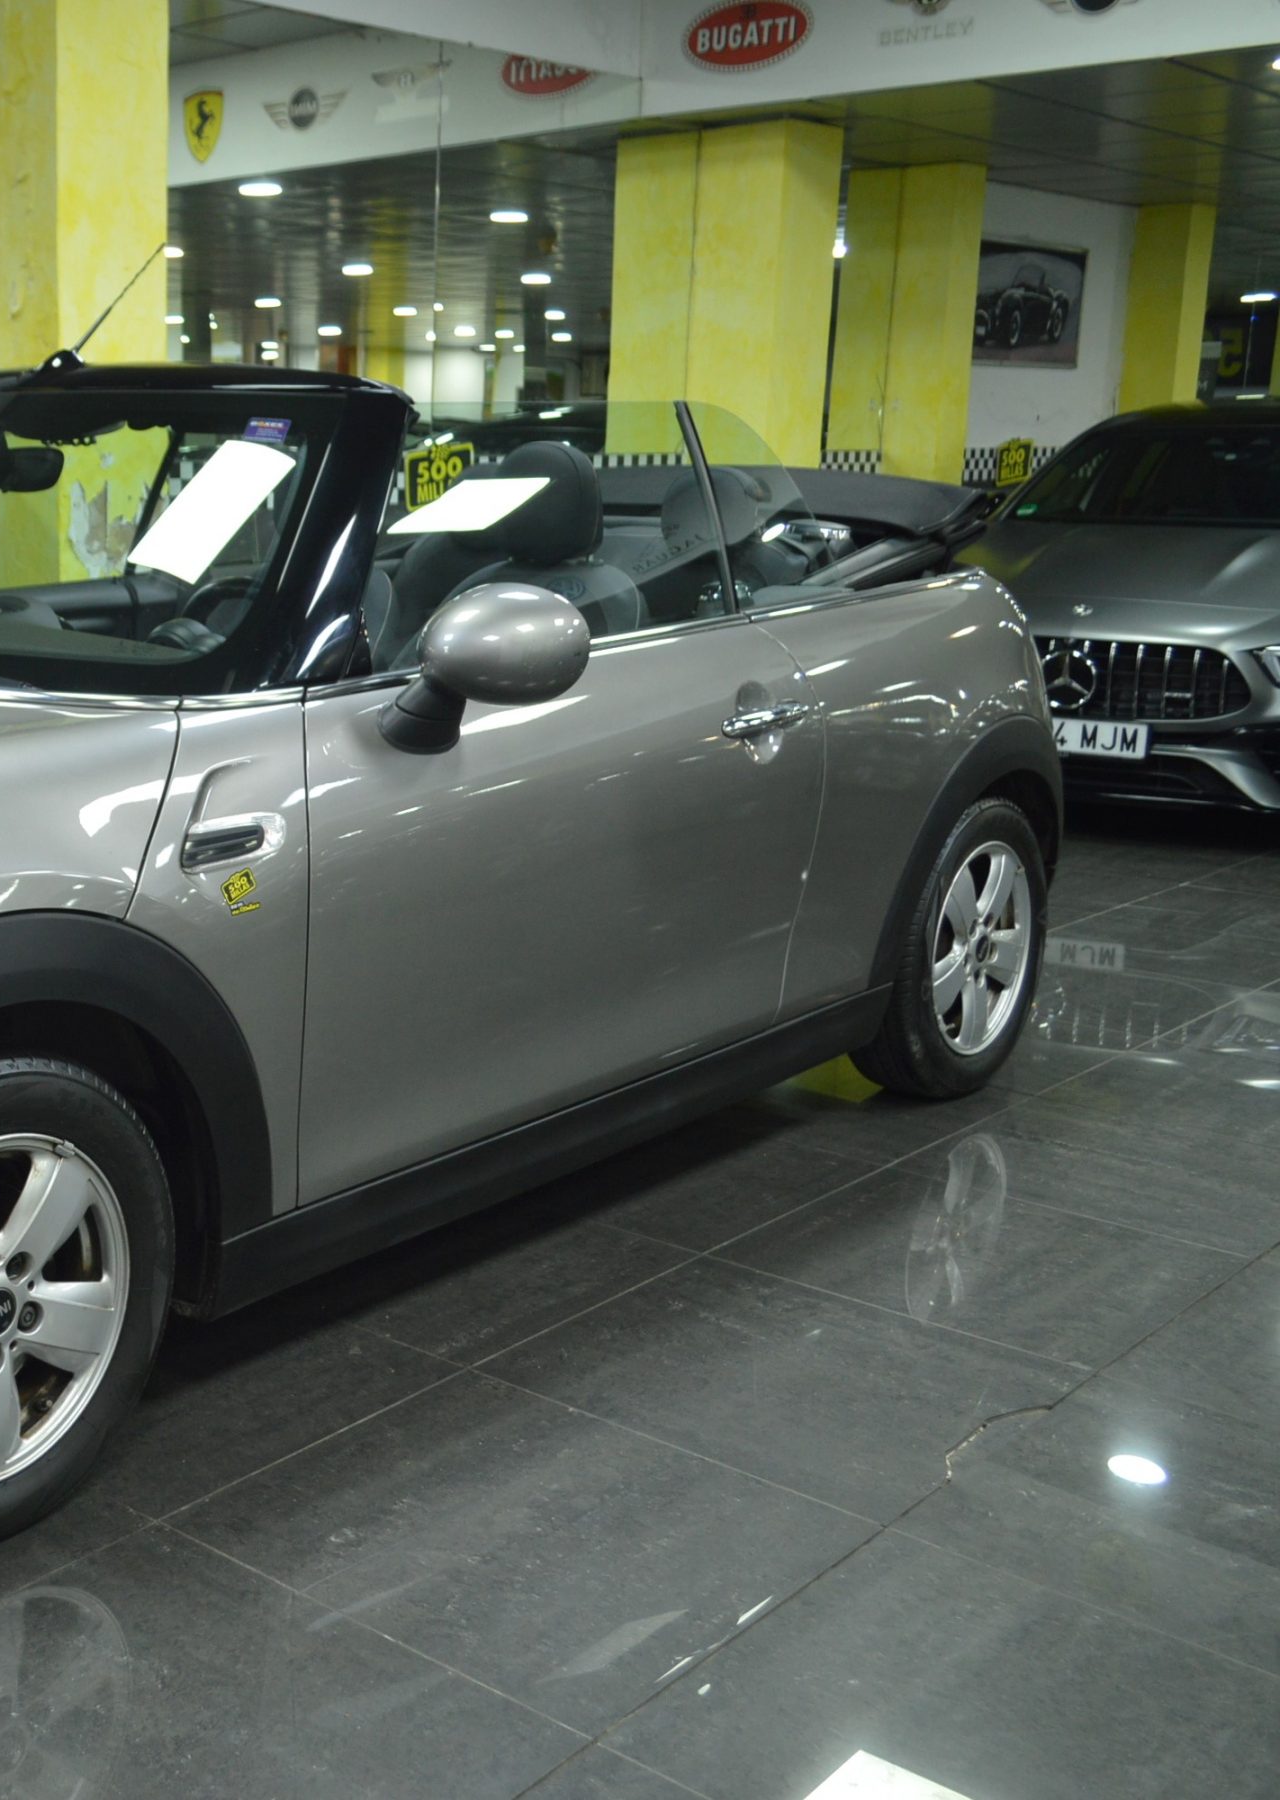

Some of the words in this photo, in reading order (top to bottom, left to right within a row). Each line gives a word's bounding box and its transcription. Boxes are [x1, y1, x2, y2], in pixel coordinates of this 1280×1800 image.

[696, 15, 796, 54] BUGATTI
[879, 16, 975, 46] BENTLEY
[416, 455, 463, 484] 500
[1001, 447, 1026, 466] 500
[416, 479, 453, 504] MILL
[1080, 724, 1138, 753] MJM
[228, 876, 248, 893] 500
